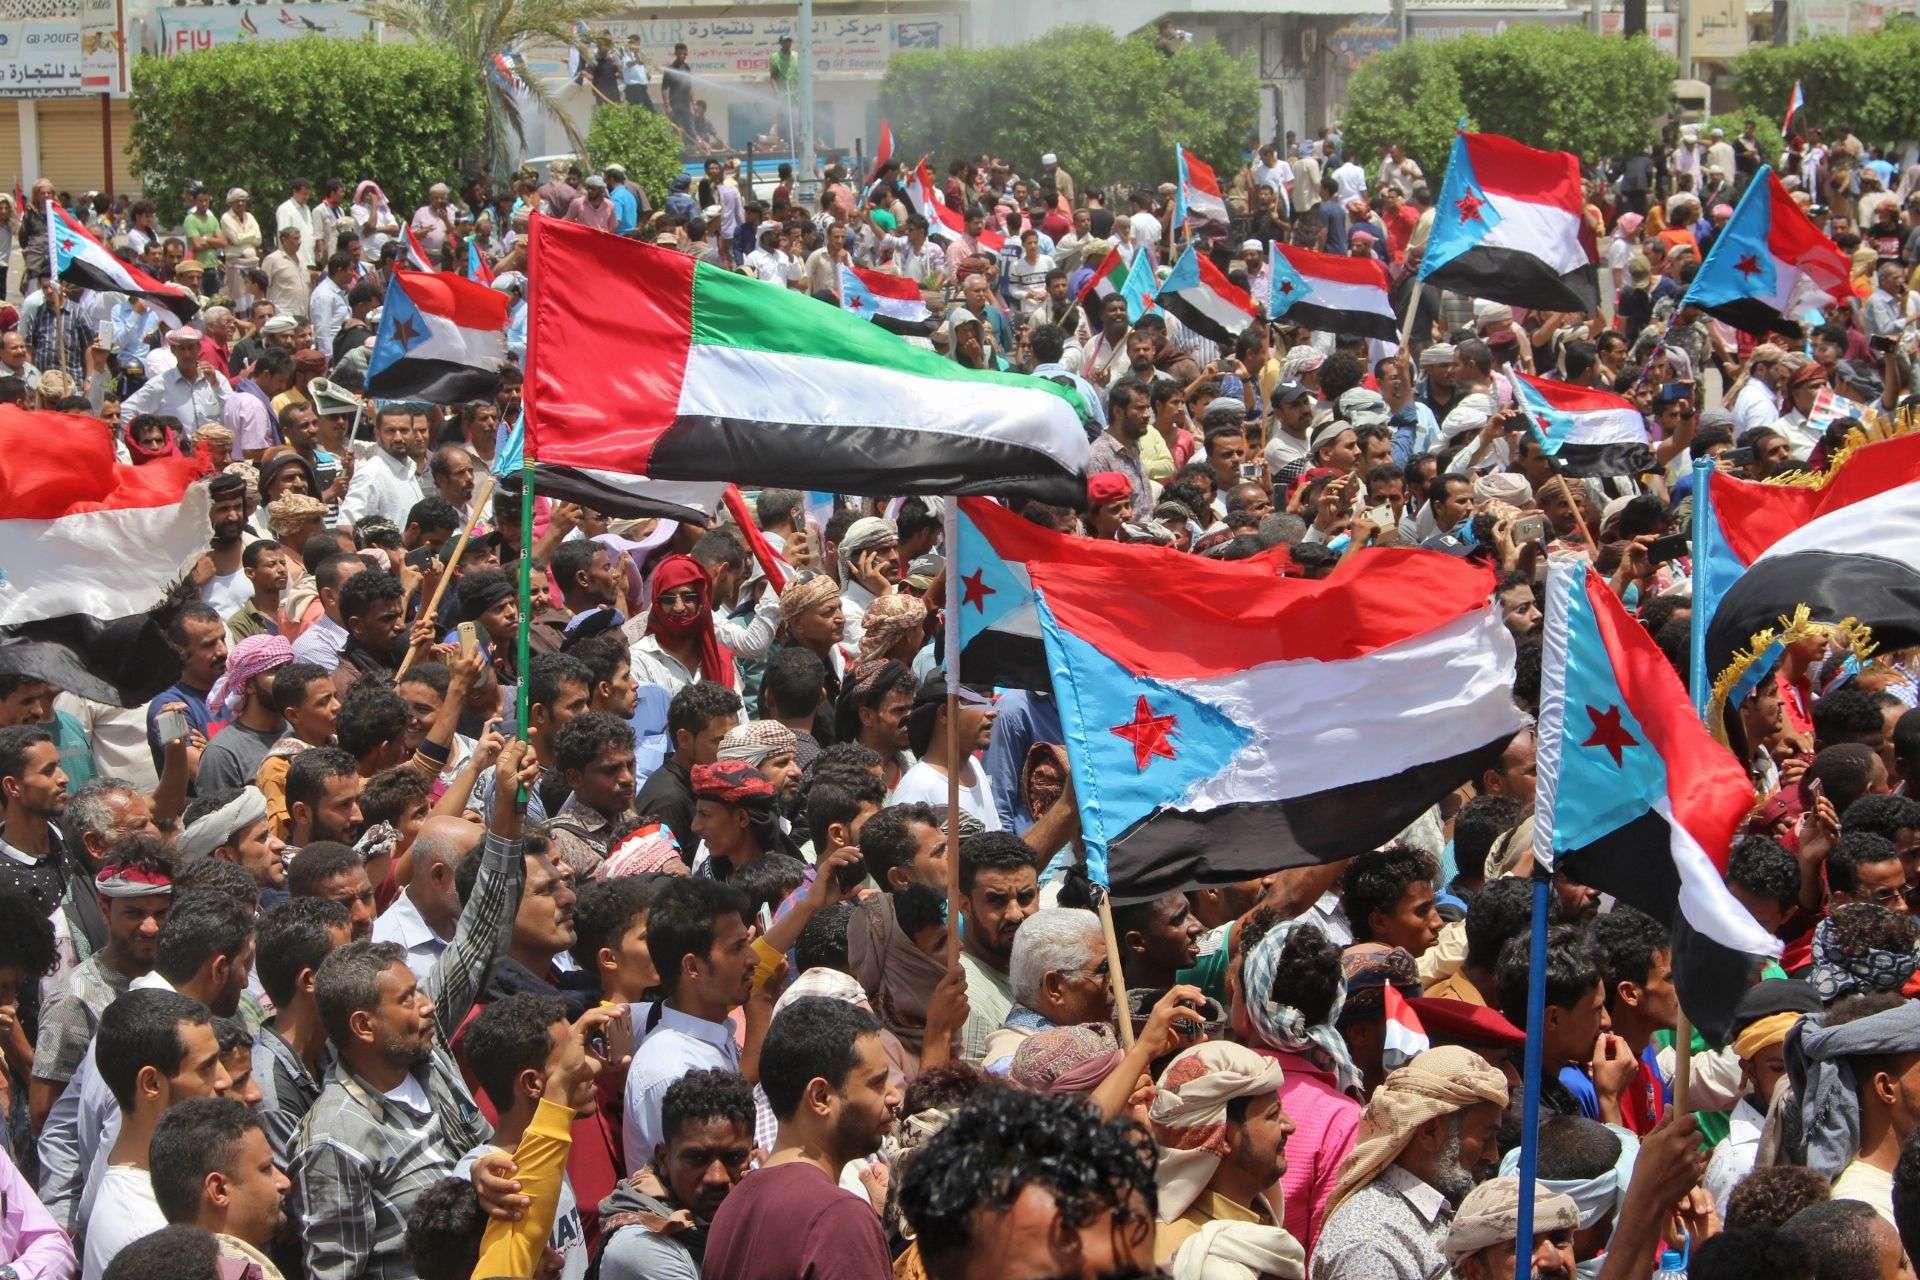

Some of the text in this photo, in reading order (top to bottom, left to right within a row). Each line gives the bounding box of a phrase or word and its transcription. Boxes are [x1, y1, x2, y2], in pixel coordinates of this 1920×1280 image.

[688, 20, 754, 39] للتجارة
[835, 19, 882, 36] مركز
[9, 63, 65, 84] للتجارة
